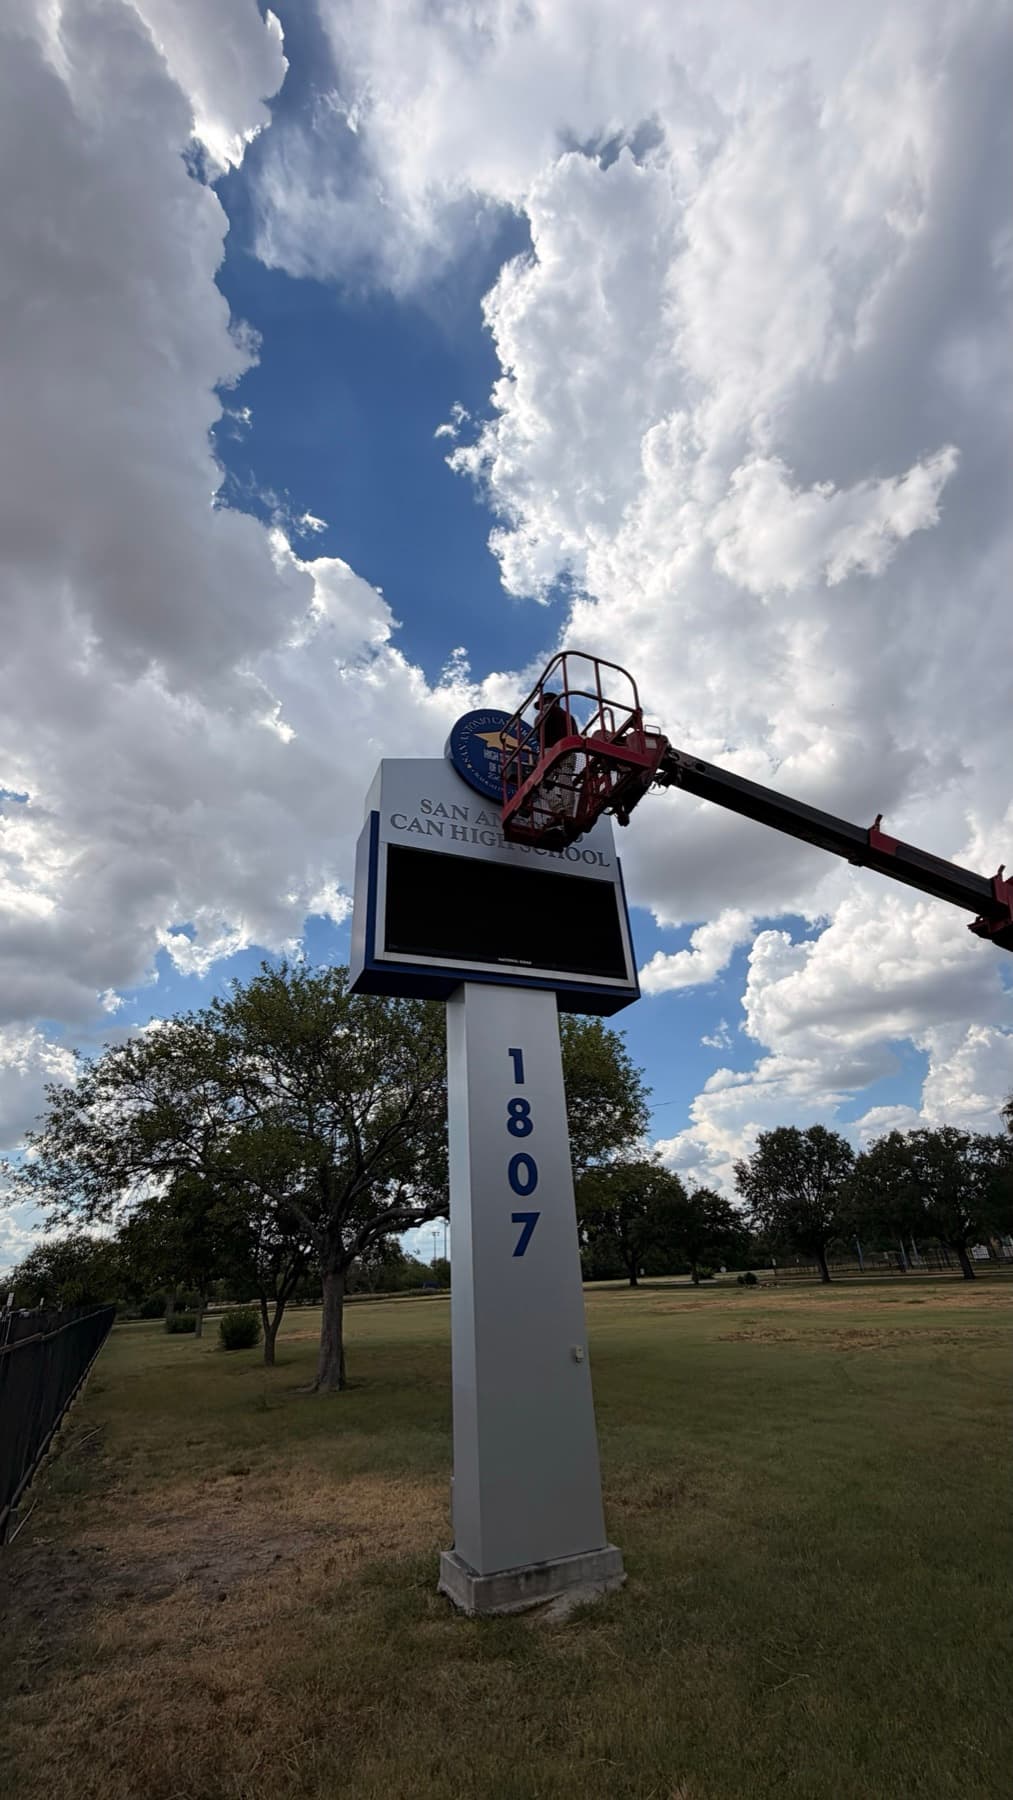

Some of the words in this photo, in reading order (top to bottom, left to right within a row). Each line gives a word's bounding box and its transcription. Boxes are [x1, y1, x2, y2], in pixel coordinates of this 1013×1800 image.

[420, 798, 470, 821] SAN
[390, 813, 445, 837] CAN
[507, 1048, 541, 1258] 1807
